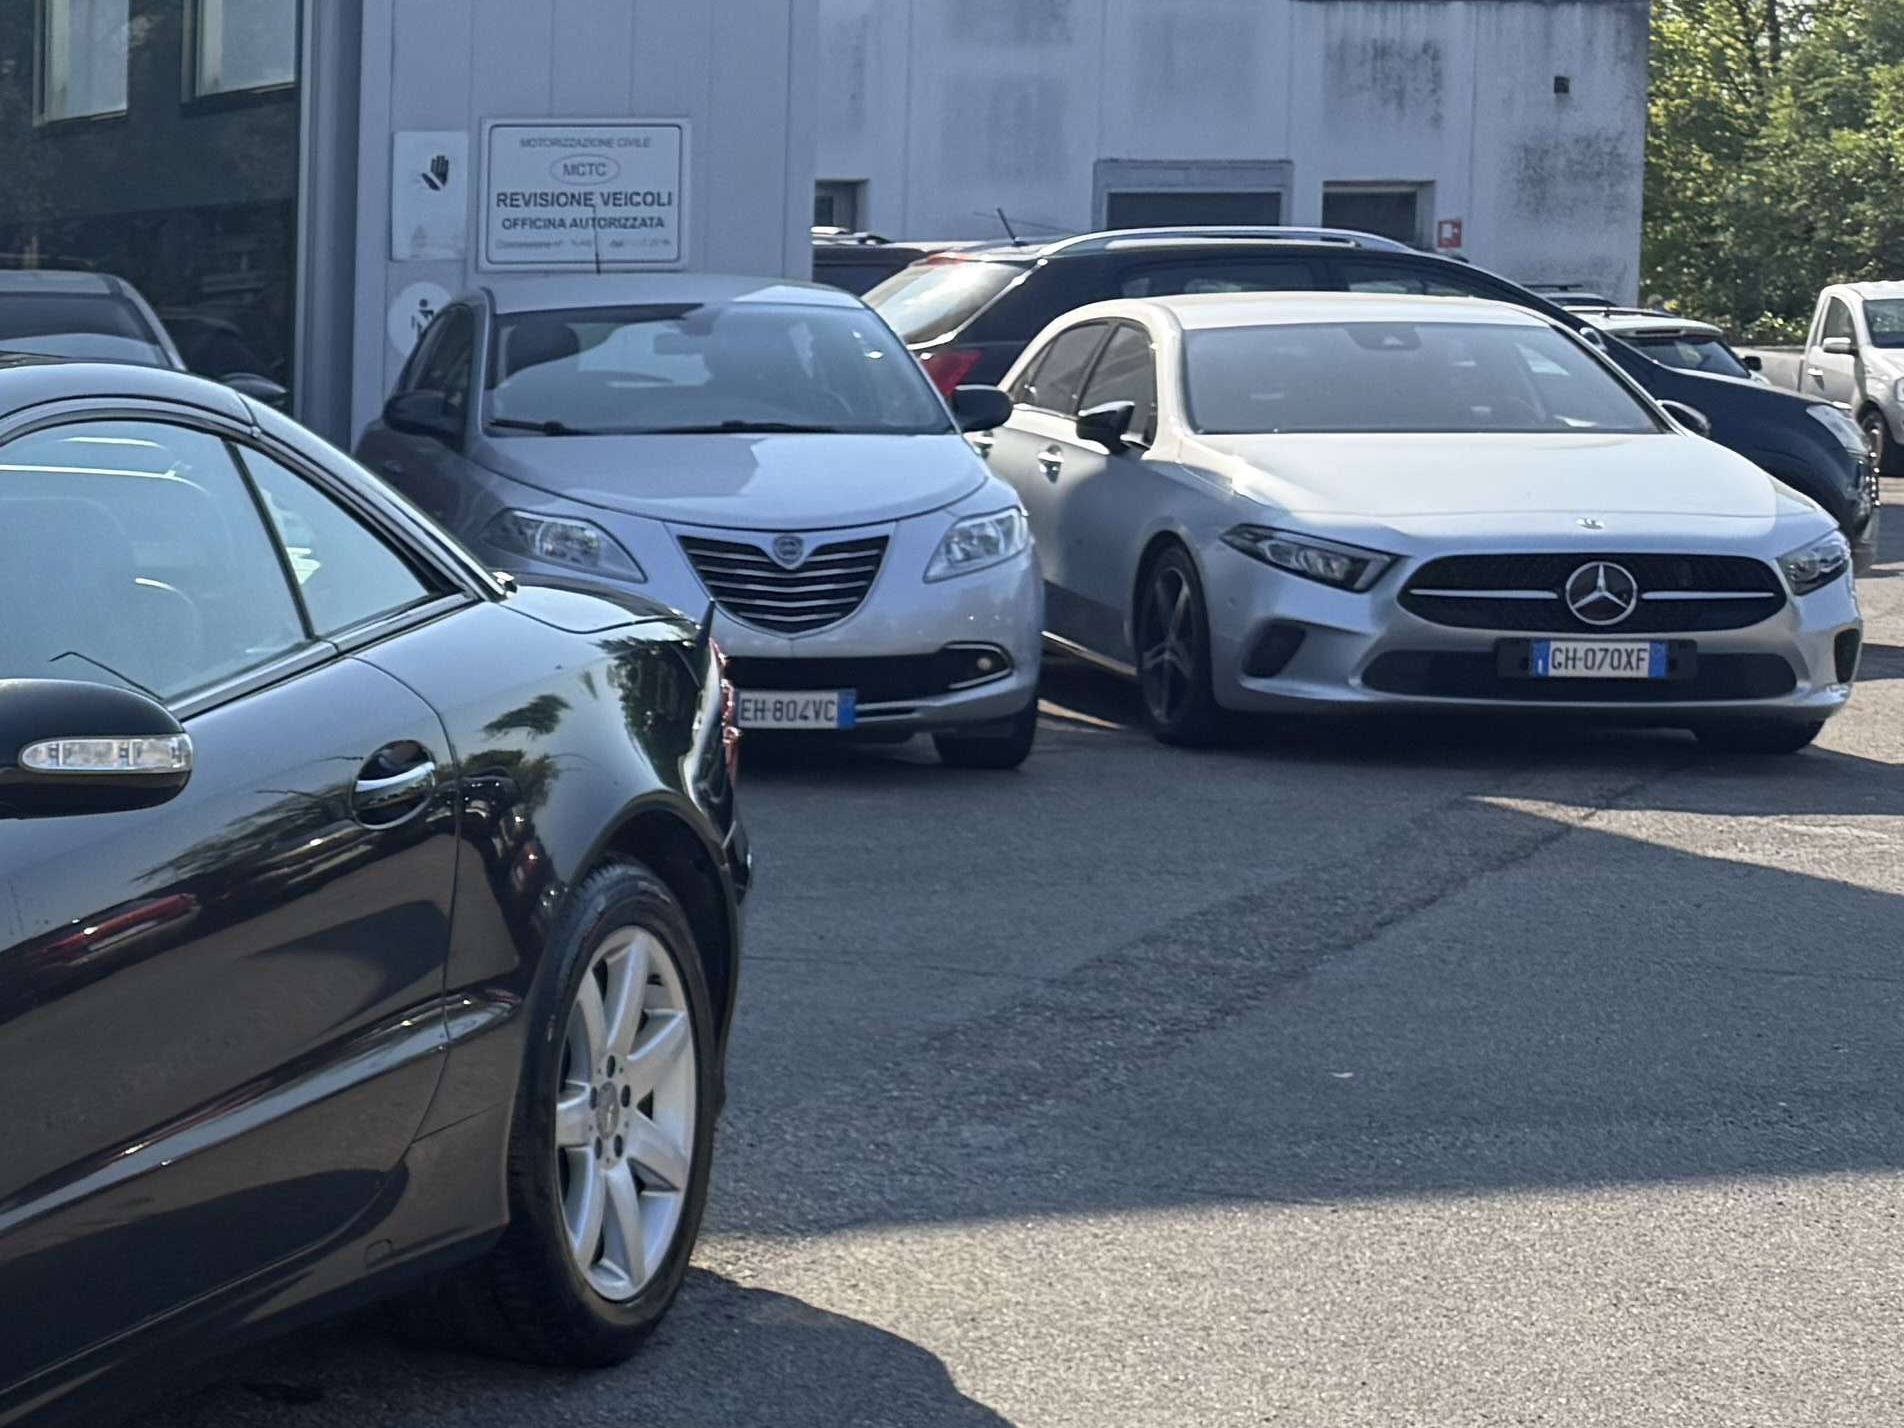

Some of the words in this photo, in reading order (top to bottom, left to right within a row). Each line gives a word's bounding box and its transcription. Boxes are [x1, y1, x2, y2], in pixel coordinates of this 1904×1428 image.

[495, 191, 595, 208] REVISIONE
[599, 190, 673, 208] VEICOLI
[501, 217, 567, 231] OFFICINA
[569, 216, 665, 230] AUTORIZZATA
